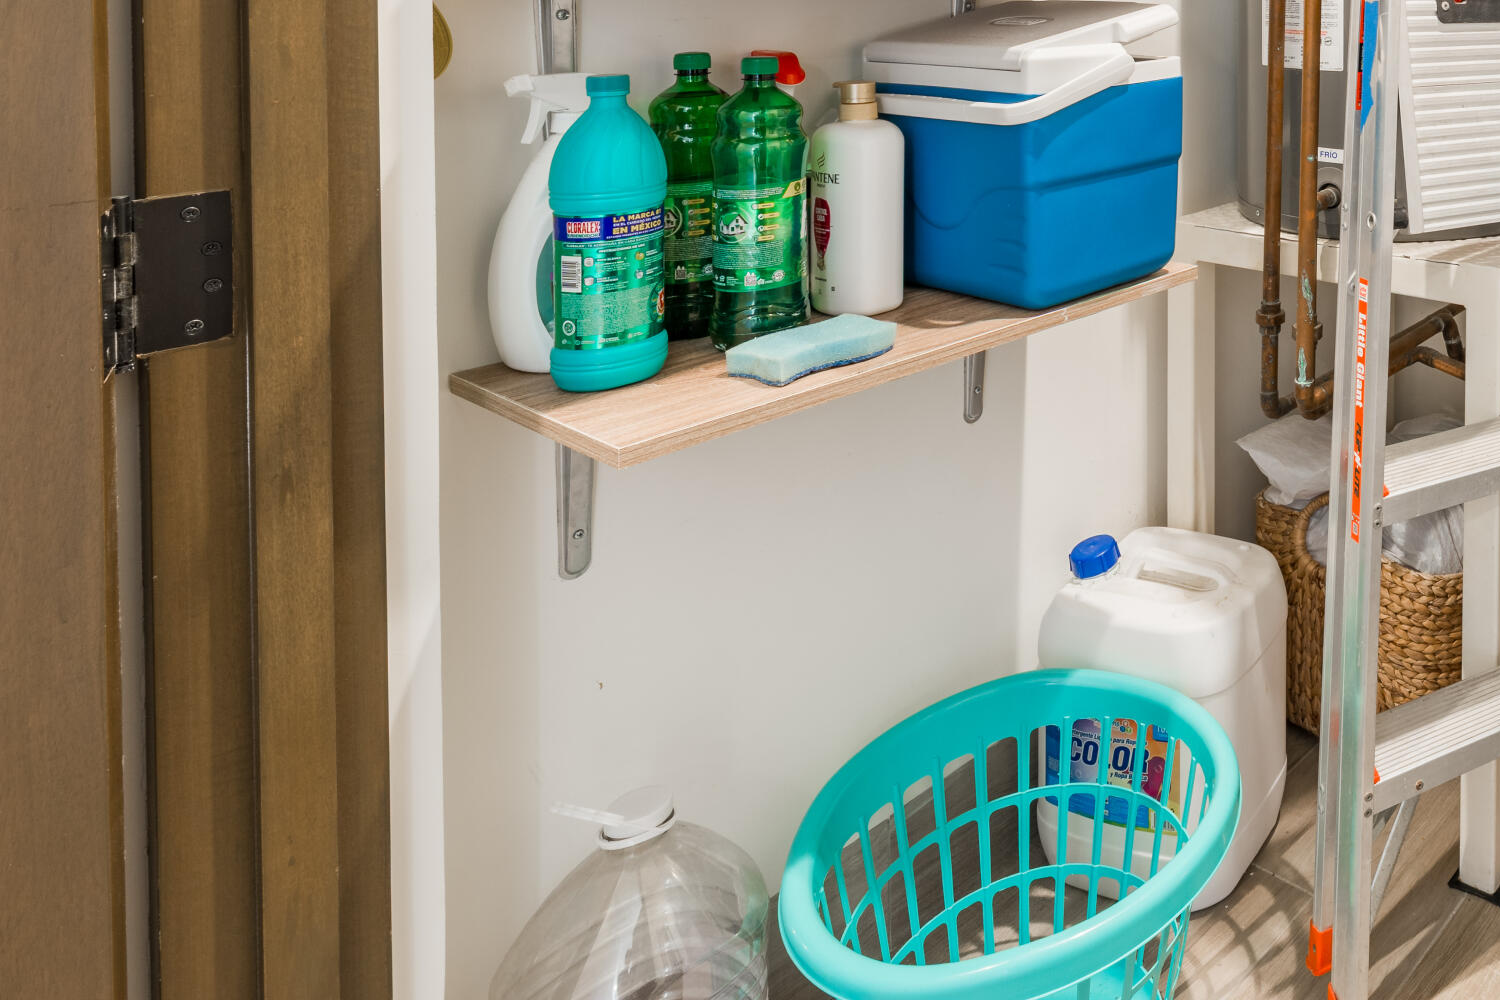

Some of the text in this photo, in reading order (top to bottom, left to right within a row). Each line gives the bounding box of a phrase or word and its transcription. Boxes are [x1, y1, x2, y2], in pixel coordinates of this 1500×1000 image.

[628, 211, 654, 221] MARCA
[566, 221, 599, 234] CLORALEX
[631, 219, 662, 232] MÉXICO
[1355, 312, 1367, 408] Little Giant
